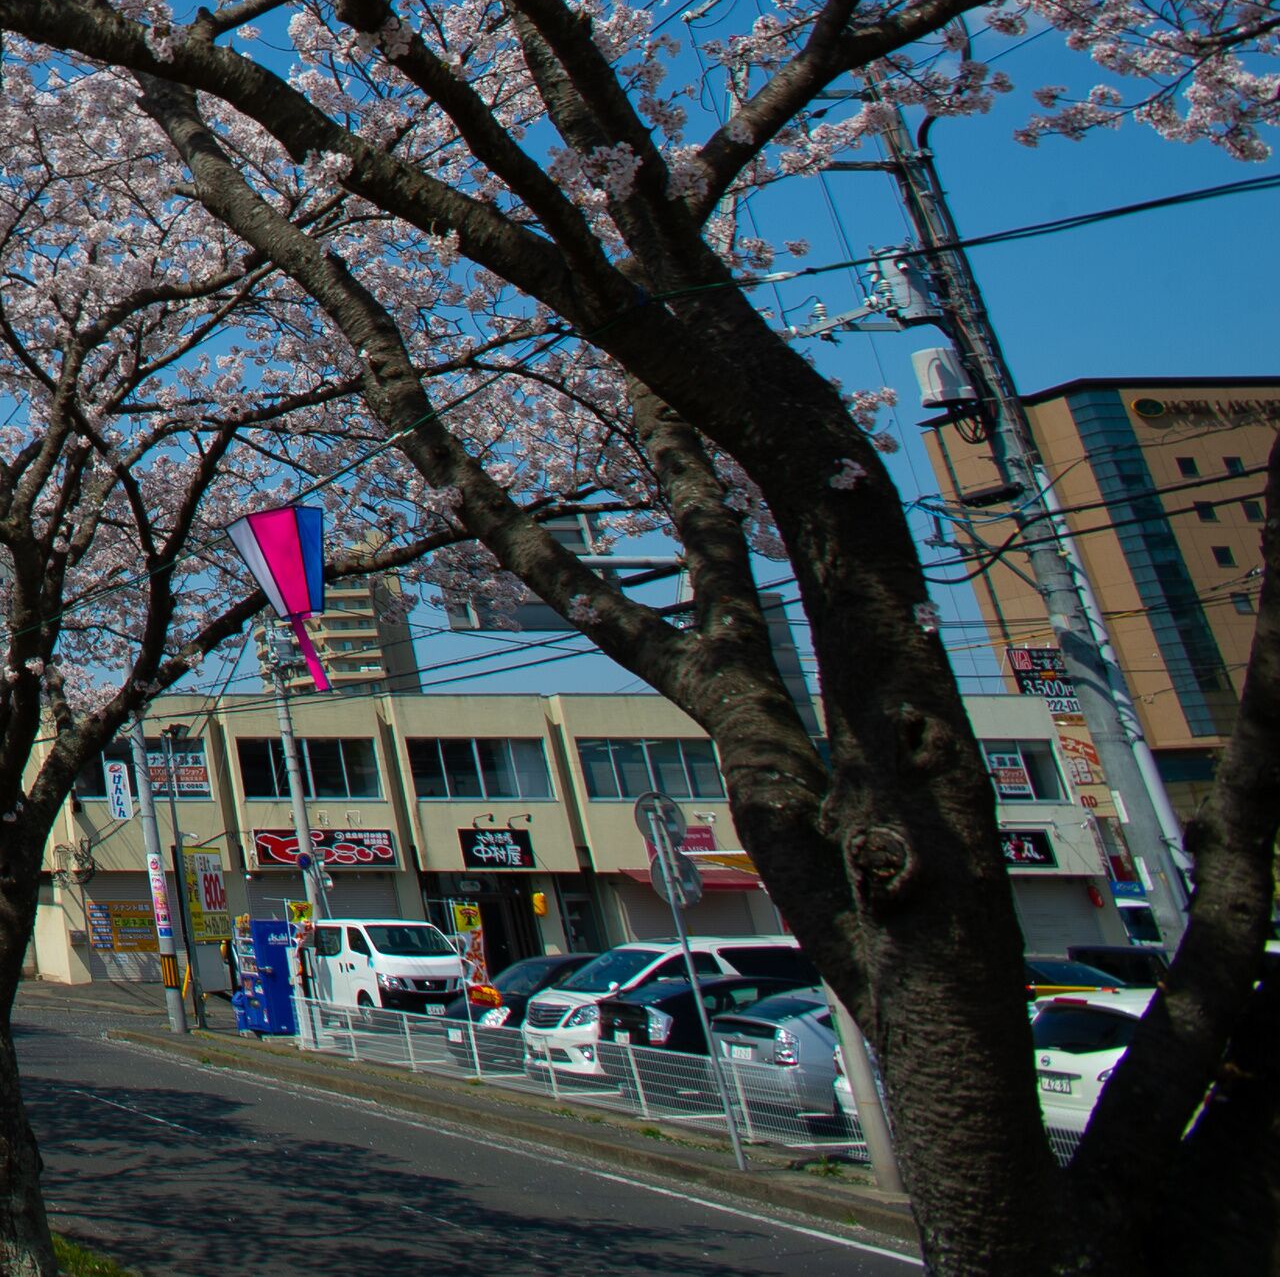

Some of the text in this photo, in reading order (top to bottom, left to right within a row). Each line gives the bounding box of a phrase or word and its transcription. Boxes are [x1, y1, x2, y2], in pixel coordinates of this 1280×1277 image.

[149, 754, 202, 765] ナント募集
[113, 774, 127, 818] けんしん
[472, 842, 522, 865] 中村屋
